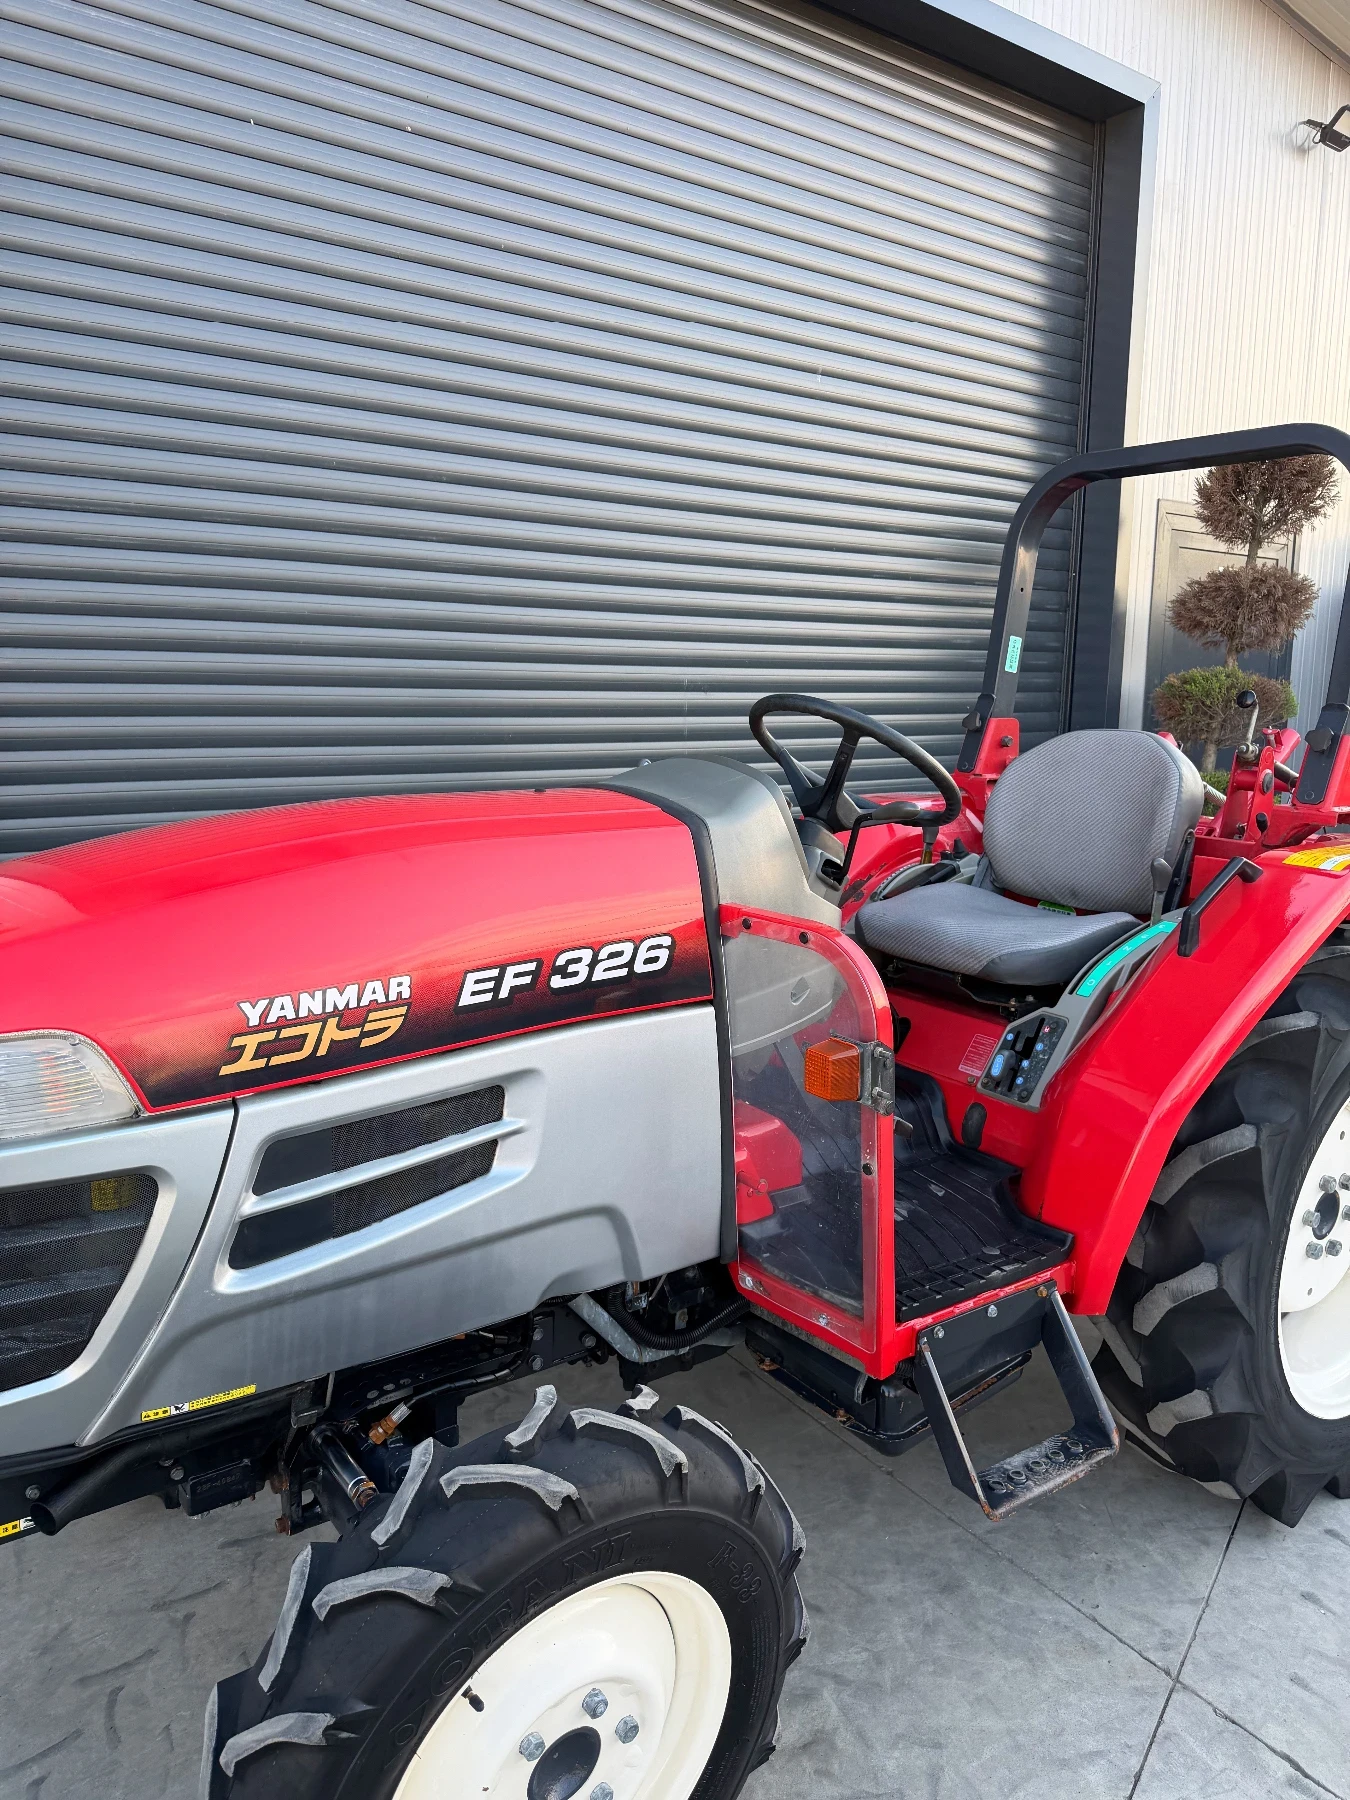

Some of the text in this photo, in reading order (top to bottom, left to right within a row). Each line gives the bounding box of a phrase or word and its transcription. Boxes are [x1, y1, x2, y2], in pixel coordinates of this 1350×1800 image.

[239, 975, 412, 1027] YANMAR
[457, 935, 673, 1008] EF 326
[220, 1006, 408, 1076] エコトラ
[431, 1531, 632, 1697] OTANI
